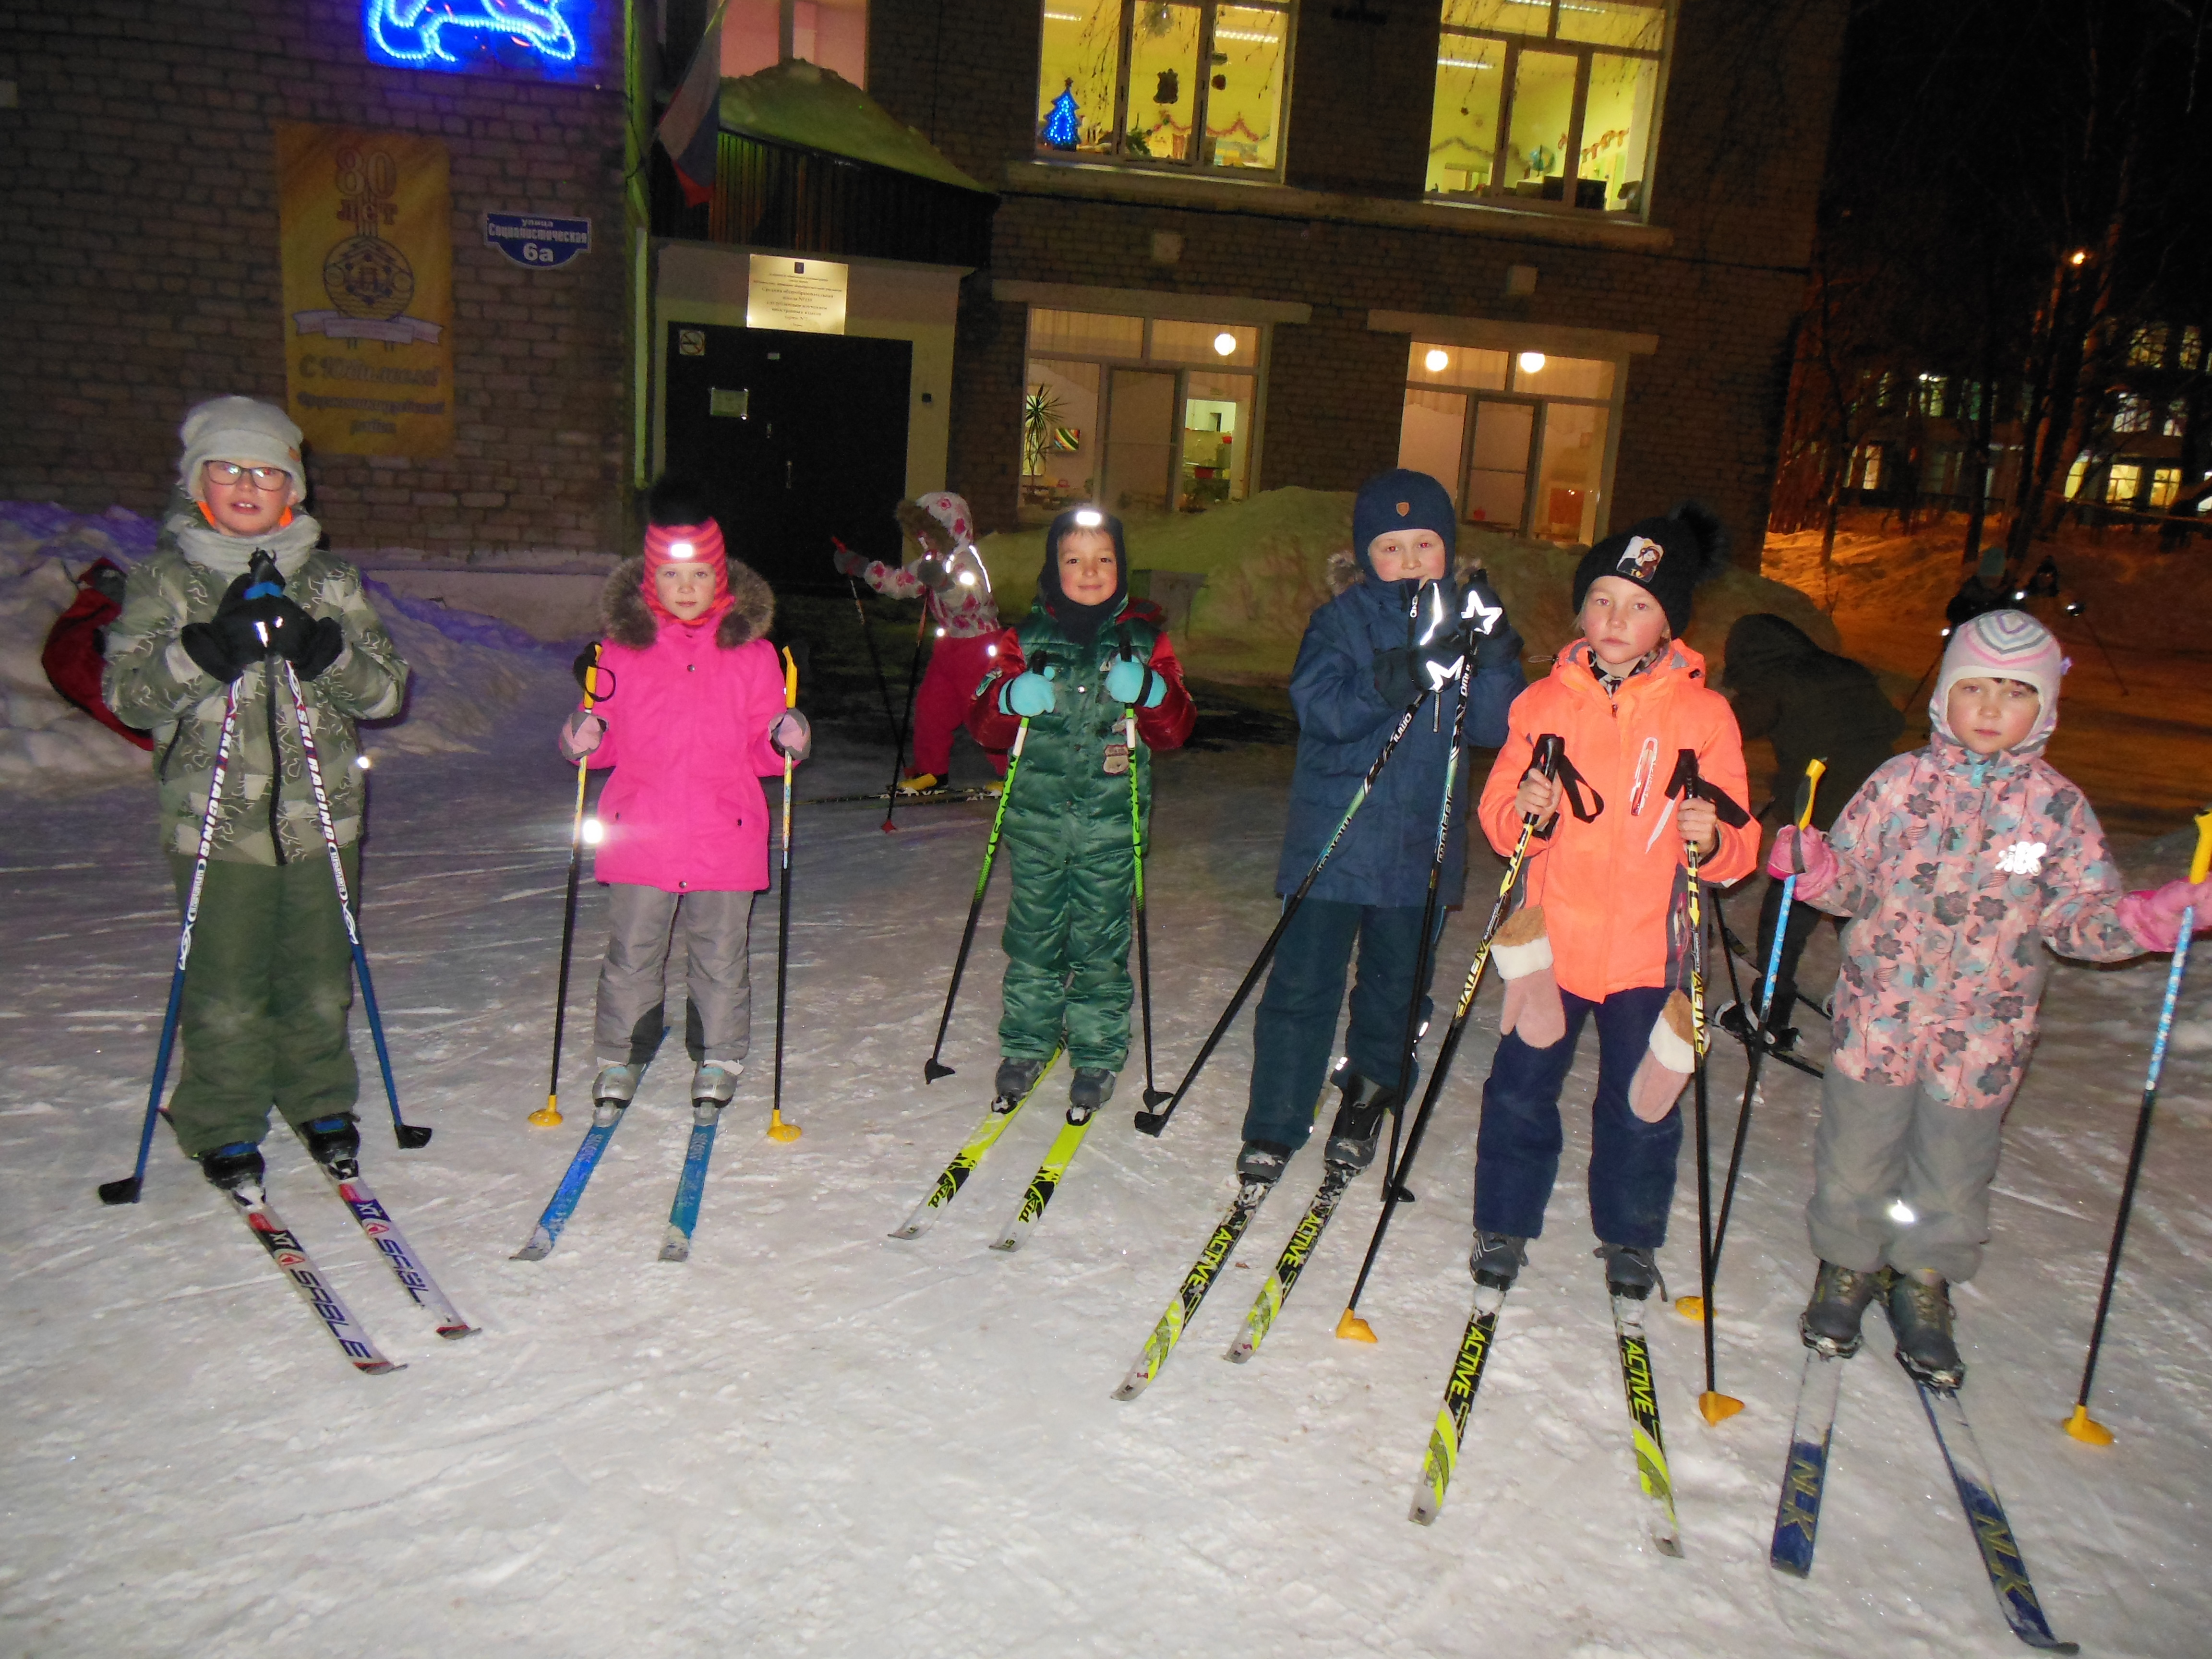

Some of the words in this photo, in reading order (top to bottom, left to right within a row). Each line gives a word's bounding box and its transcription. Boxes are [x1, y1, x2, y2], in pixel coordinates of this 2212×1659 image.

[336, 147, 397, 200] 80
[522, 218, 553, 226] улица
[296, 708, 315, 747] SKI
[306, 757, 335, 840] RACING
[1282, 1211, 1321, 1268] ACTIVE
[1451, 1326, 1487, 1398] ACTIVE
[1625, 1339, 1654, 1416] ACTIVE
